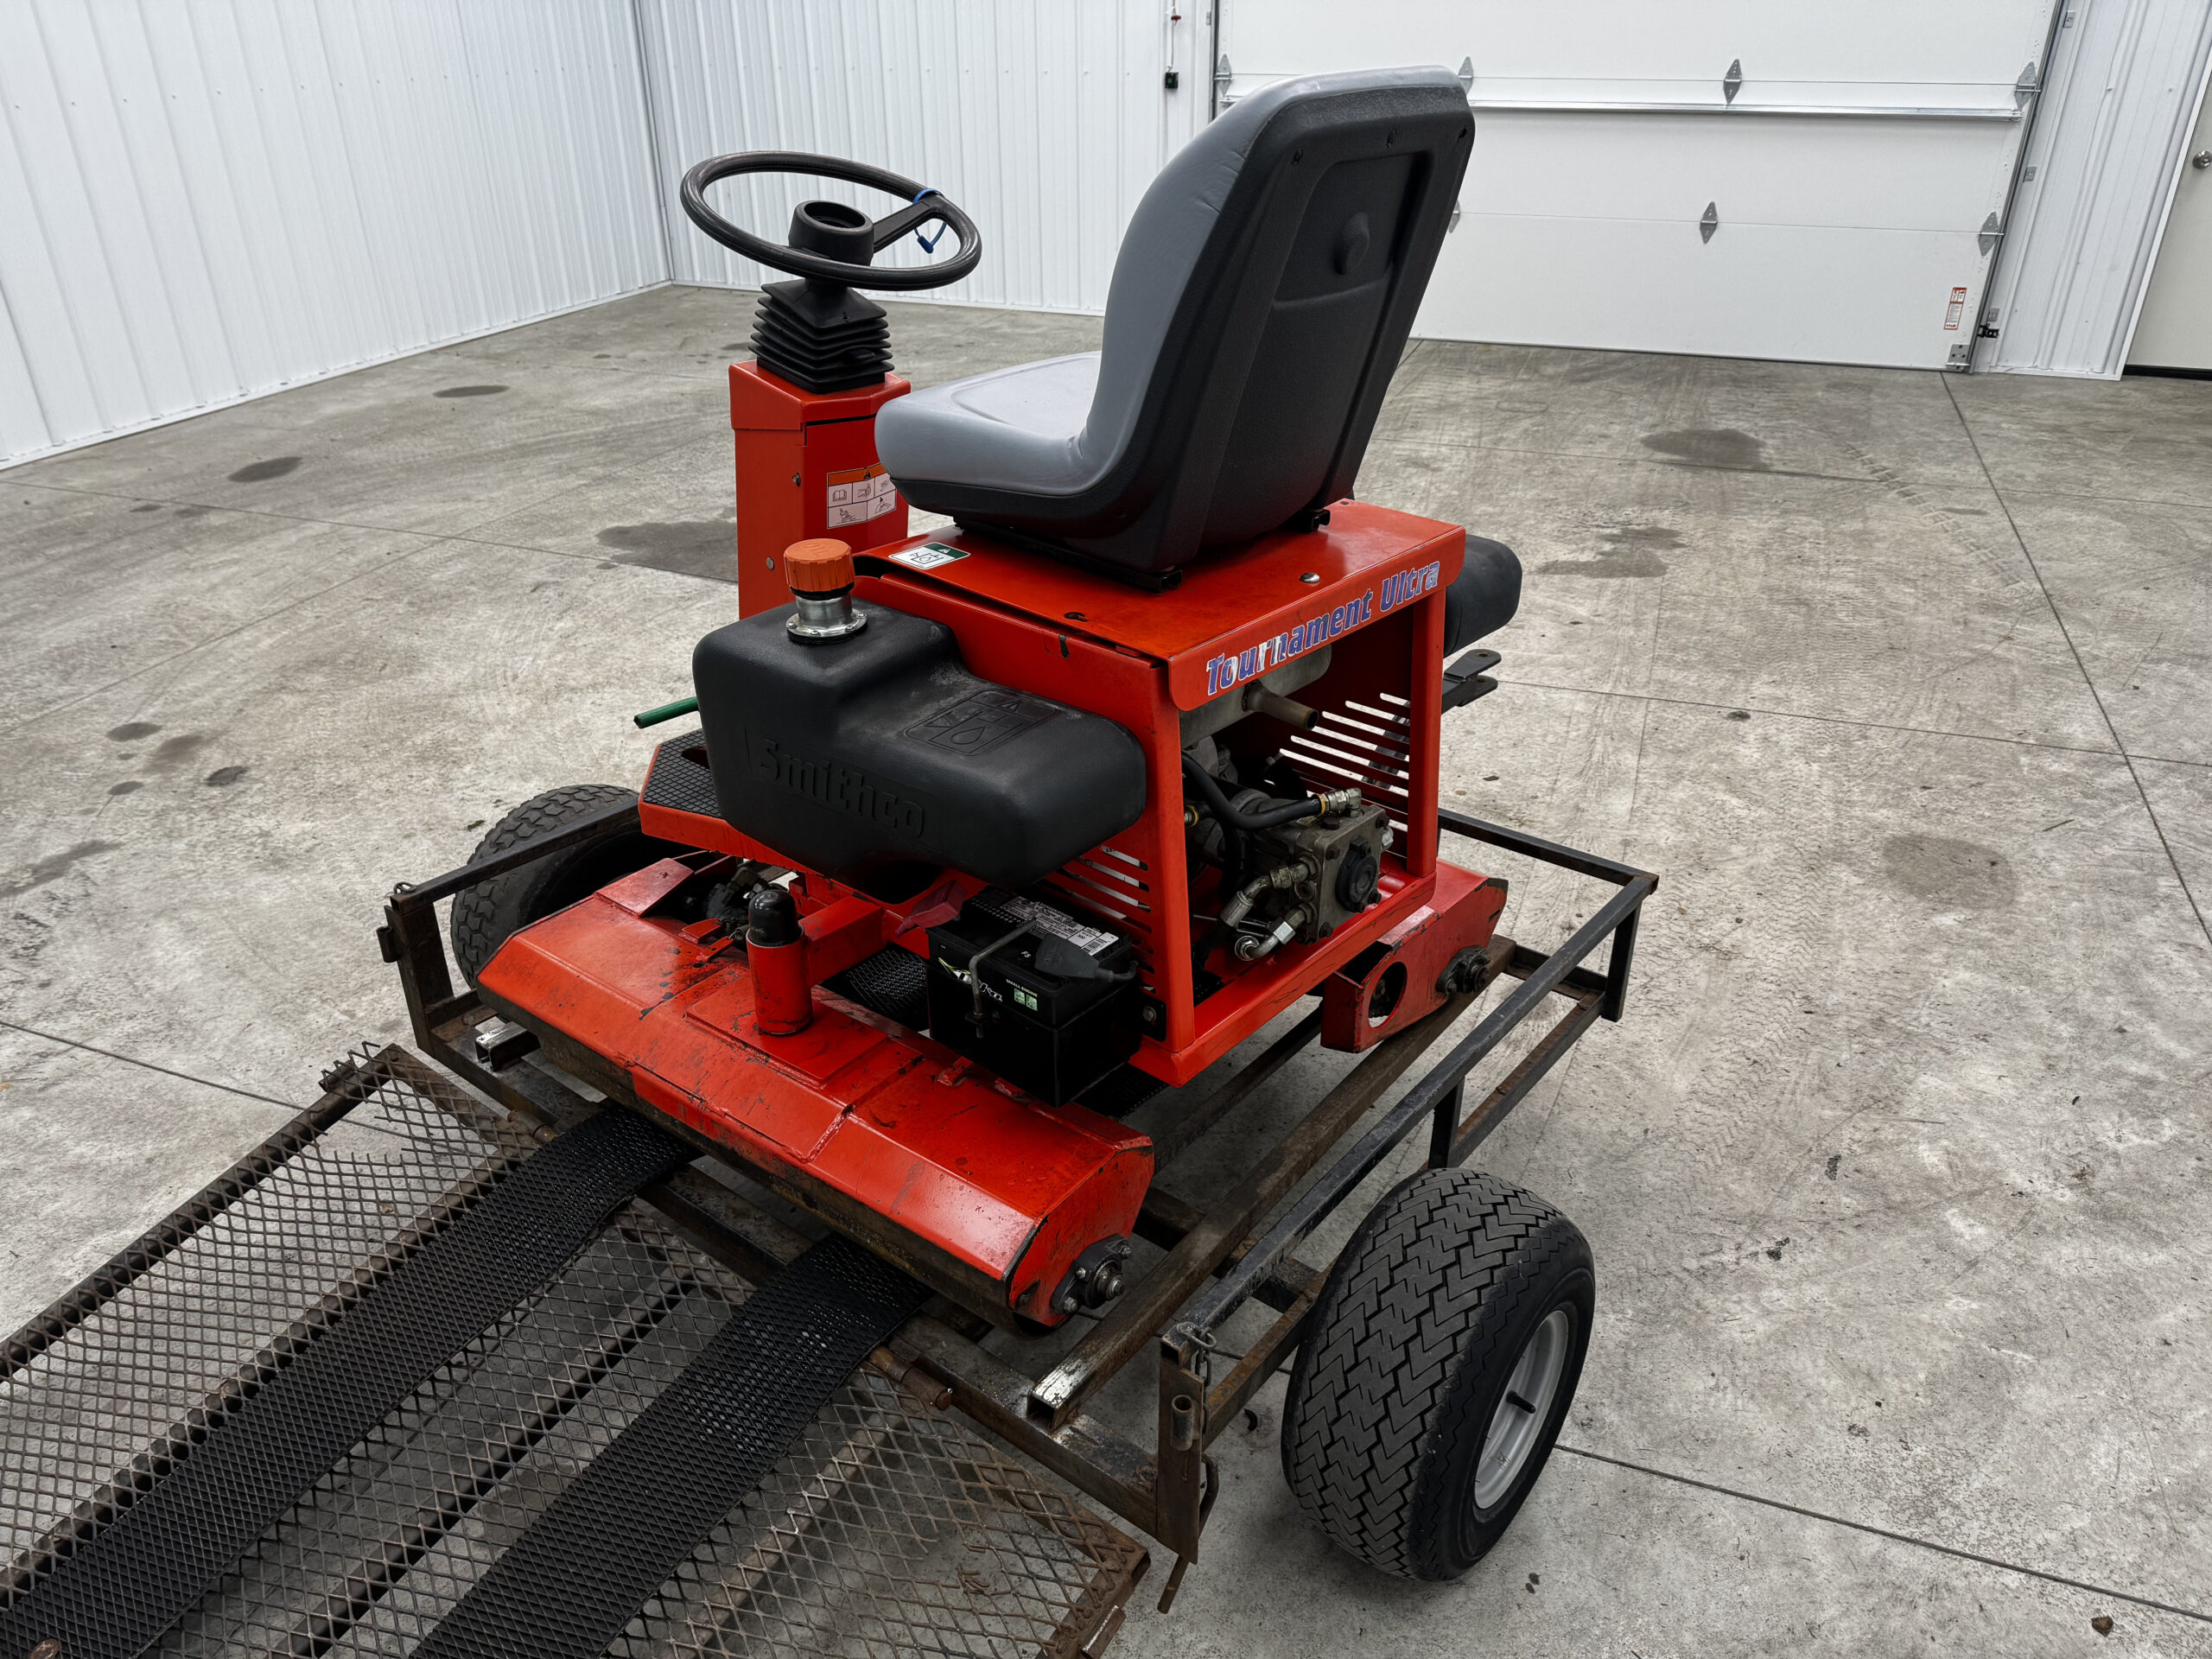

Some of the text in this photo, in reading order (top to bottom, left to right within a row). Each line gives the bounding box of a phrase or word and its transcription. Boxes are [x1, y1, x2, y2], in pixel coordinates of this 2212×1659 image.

[1205, 561, 1440, 696] Tournament Ultra
[760, 737, 925, 837] Smithco
